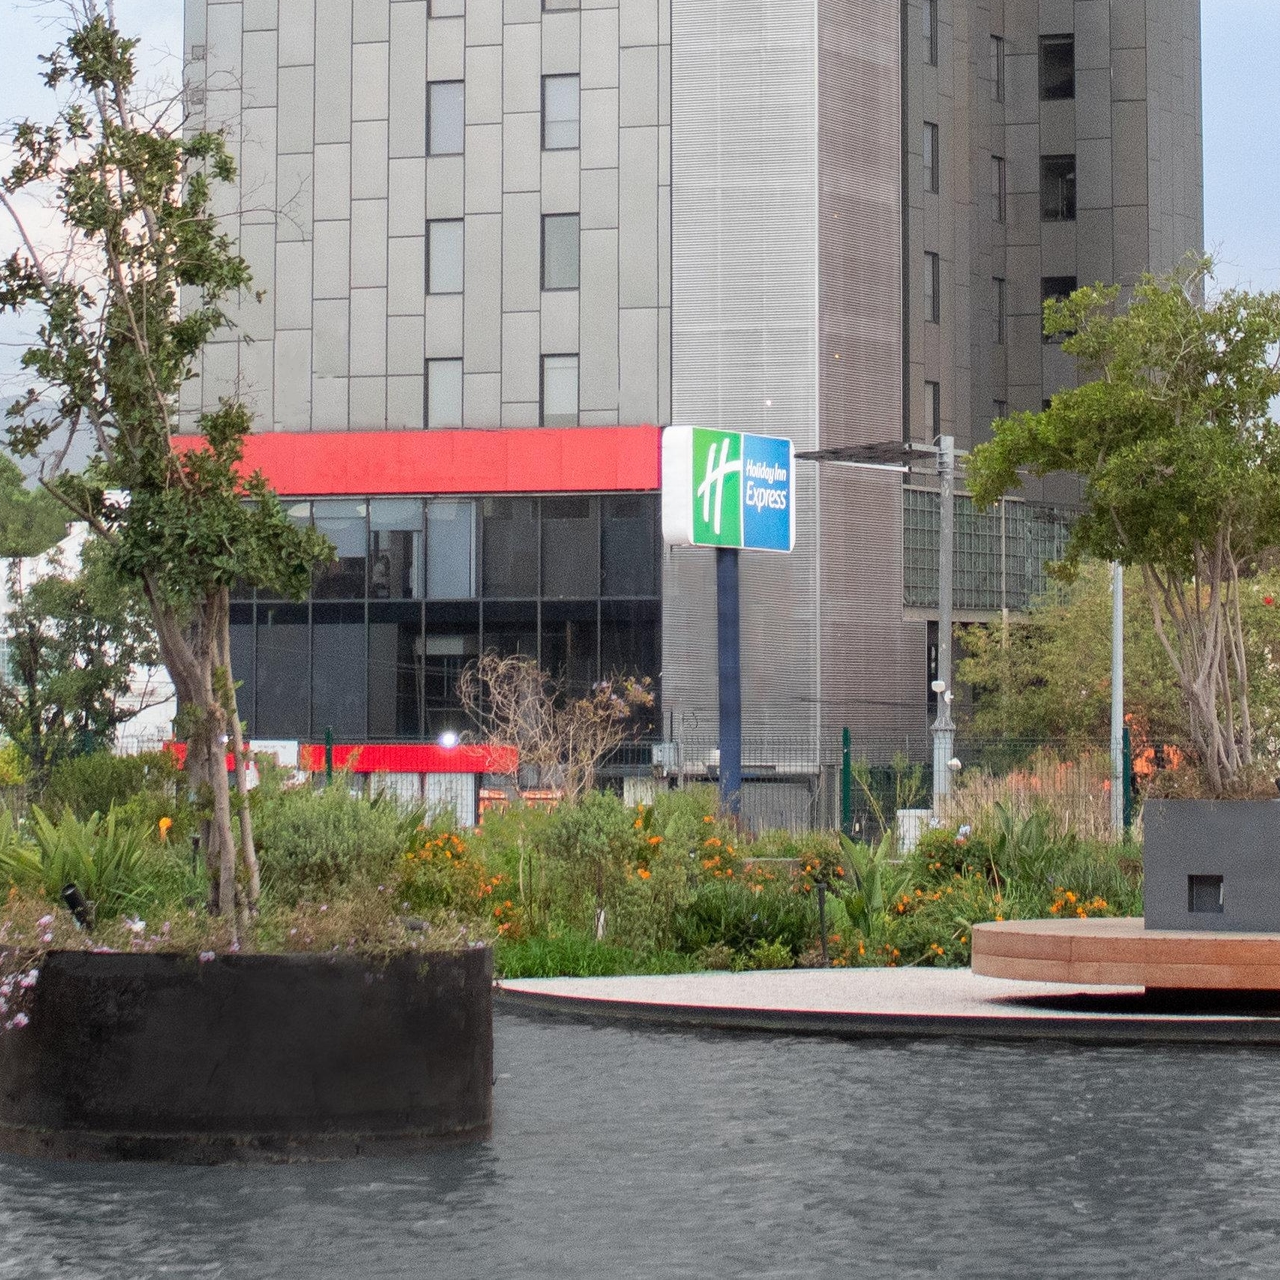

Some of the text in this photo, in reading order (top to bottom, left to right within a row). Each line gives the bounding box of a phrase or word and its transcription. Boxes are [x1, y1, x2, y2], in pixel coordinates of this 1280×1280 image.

[746, 459, 787, 484] Holiday Inn
[746, 481, 787, 512] Express
